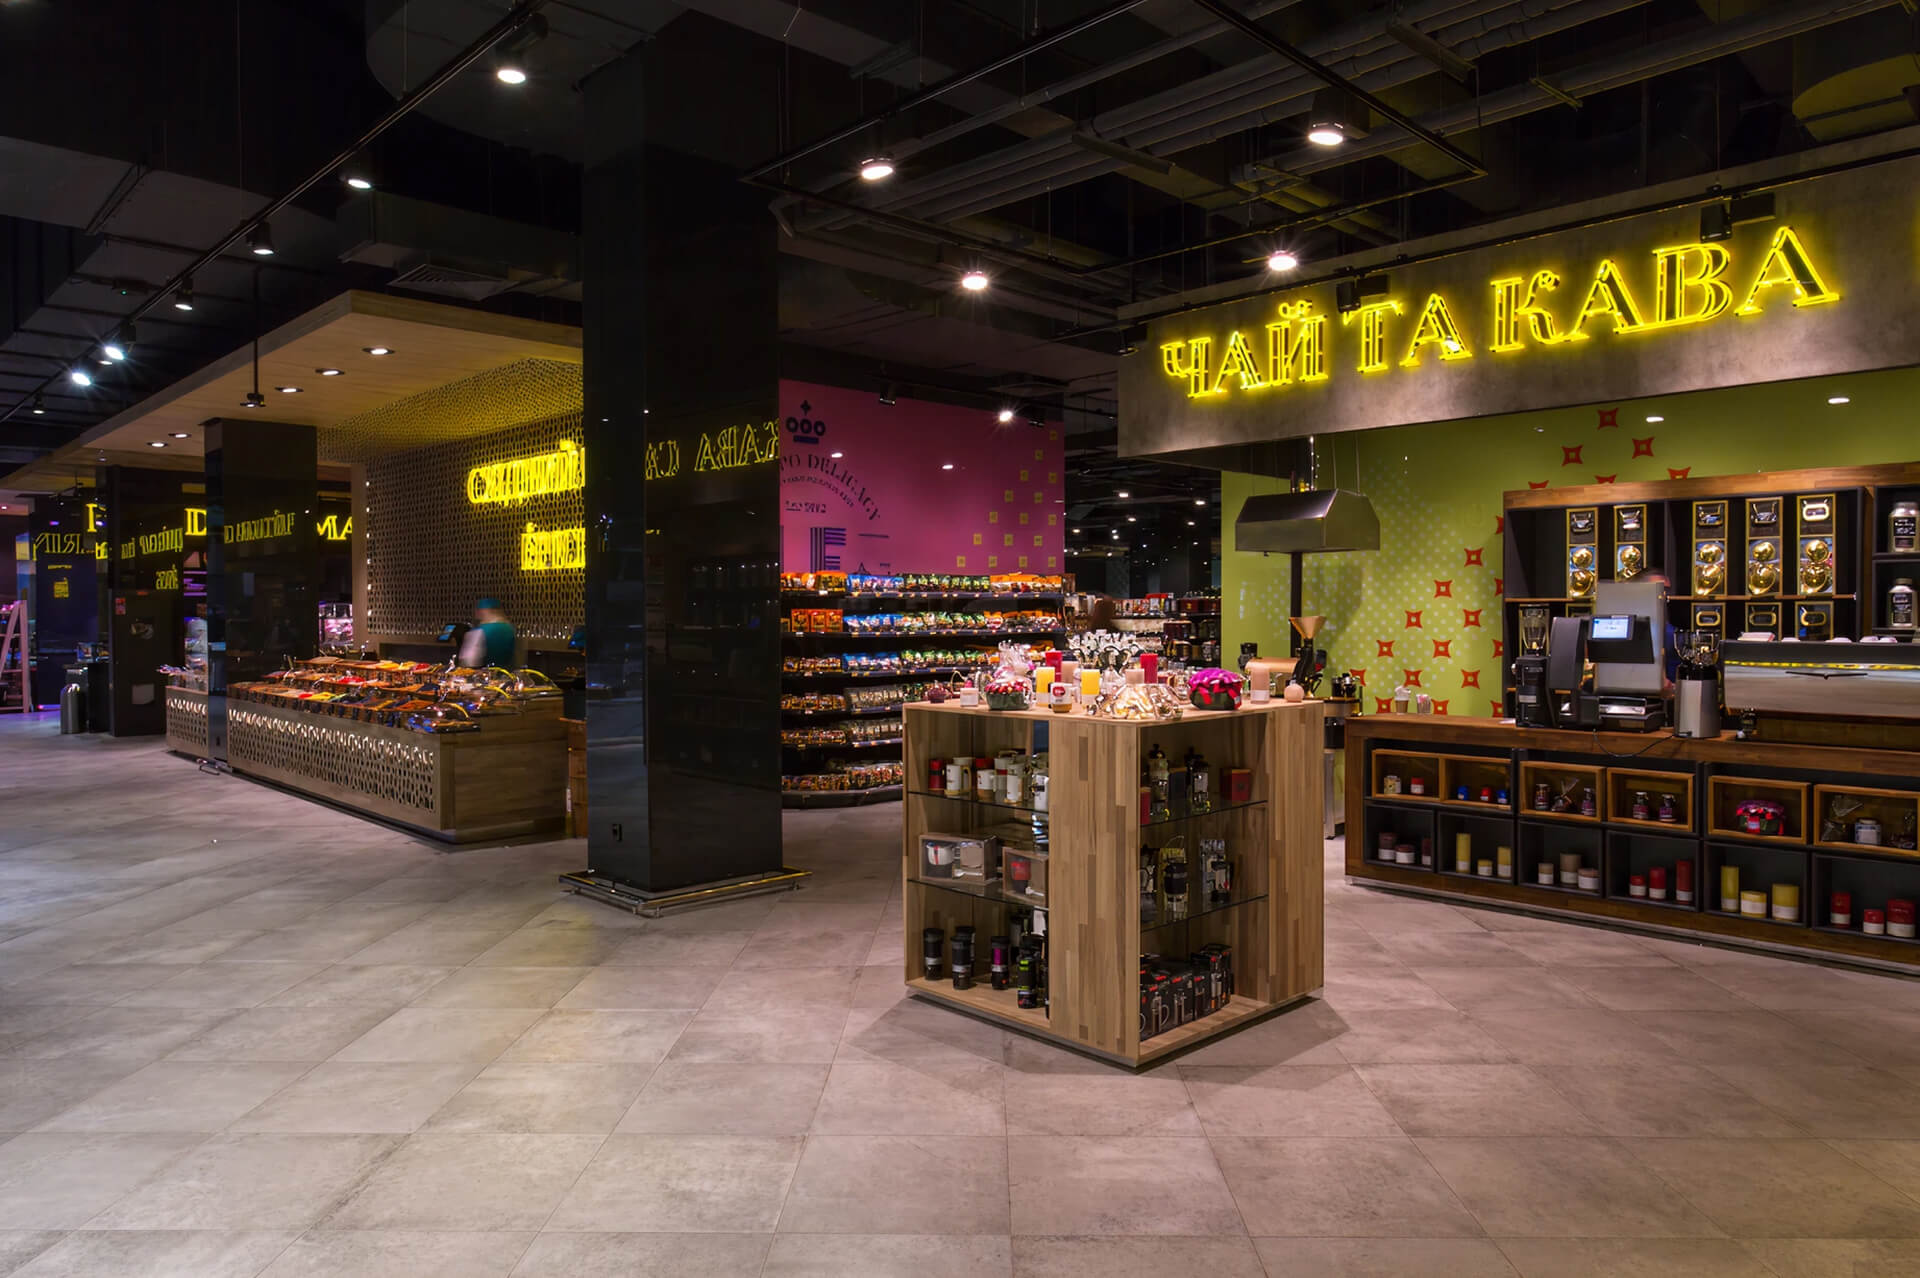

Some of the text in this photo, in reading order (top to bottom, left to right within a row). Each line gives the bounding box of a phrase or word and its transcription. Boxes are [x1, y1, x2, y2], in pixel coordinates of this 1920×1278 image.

[1159, 224, 1841, 400] ЧАЙ ТА КАВА
[807, 454, 881, 521] DELICACY
